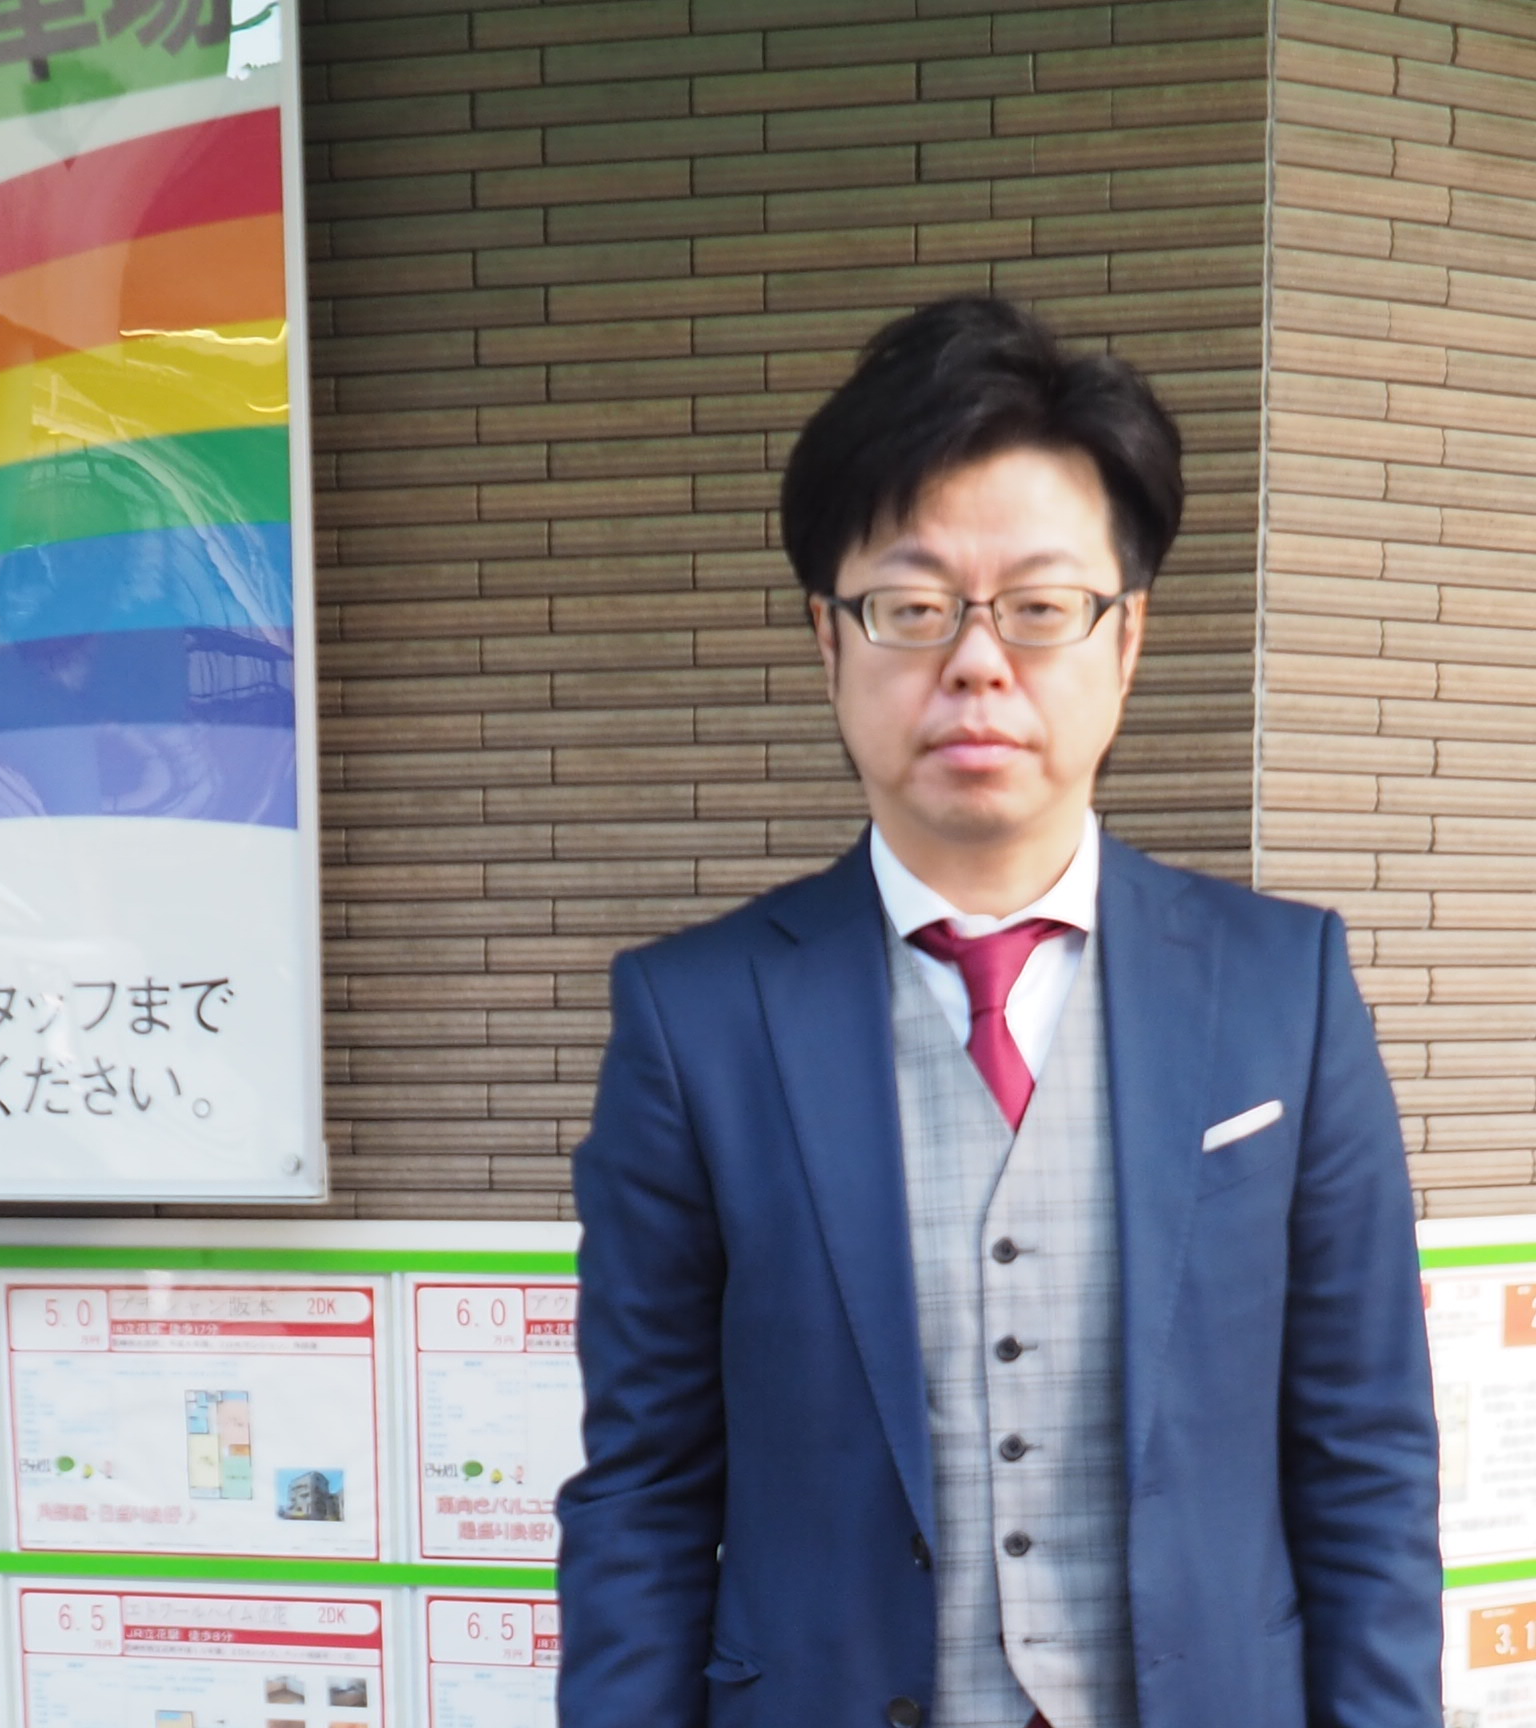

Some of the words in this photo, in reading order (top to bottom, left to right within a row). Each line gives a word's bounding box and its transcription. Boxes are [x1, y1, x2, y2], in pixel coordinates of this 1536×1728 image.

[44, 1298, 94, 1328] 5.0
[306, 1297, 337, 1315] 2DK
[456, 1297, 506, 1328] 6.0
[58, 1604, 105, 1632] 6.5
[317, 1606, 347, 1625] 2DK
[466, 1611, 515, 1641] 6.5
